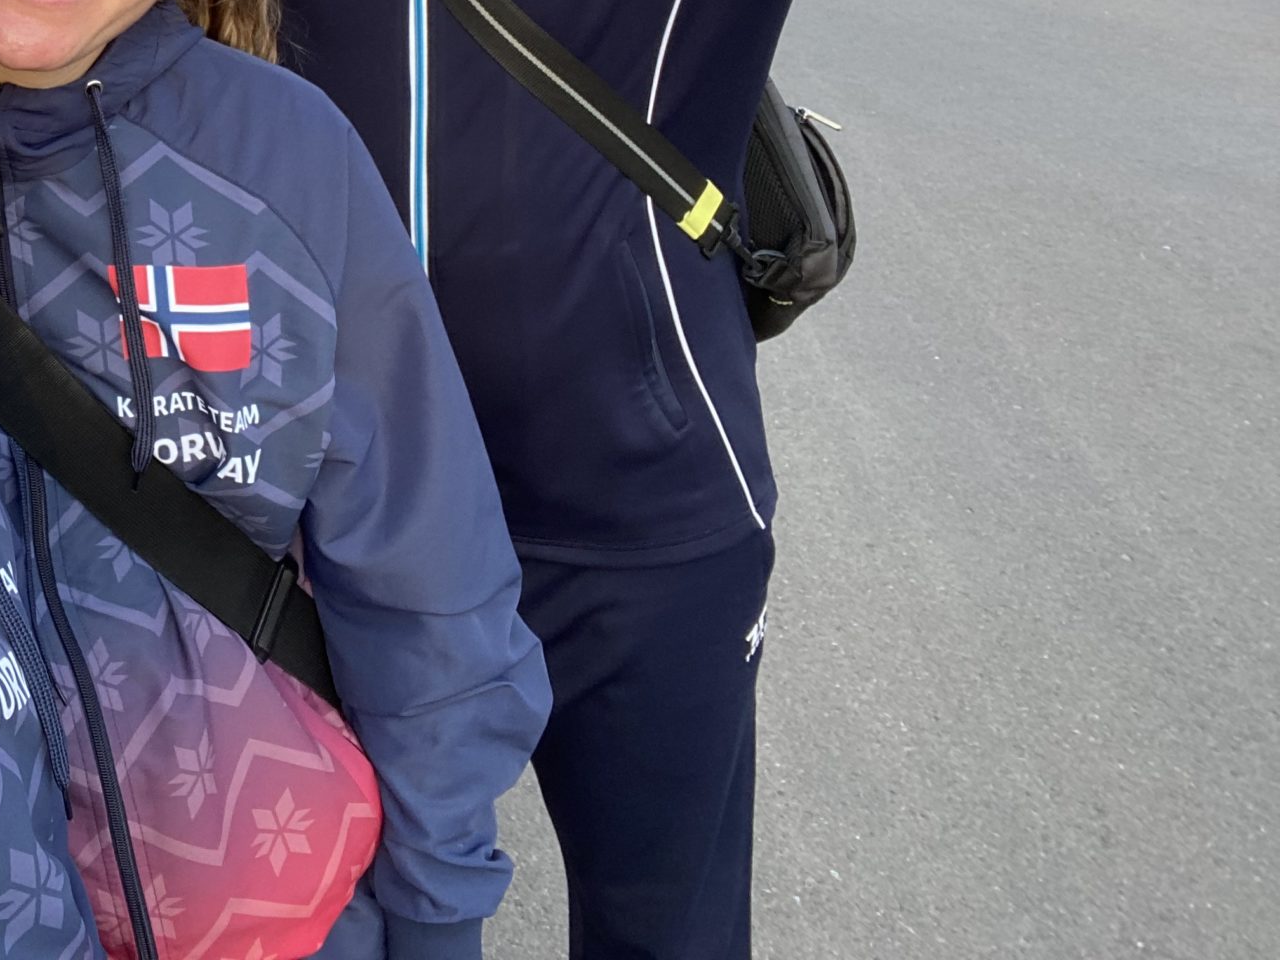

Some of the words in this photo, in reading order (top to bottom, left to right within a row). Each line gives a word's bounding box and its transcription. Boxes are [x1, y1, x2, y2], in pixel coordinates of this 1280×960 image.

[117, 391, 209, 419] KRATE
[207, 403, 260, 434] TEAM
[153, 431, 262, 484] ORWAY
